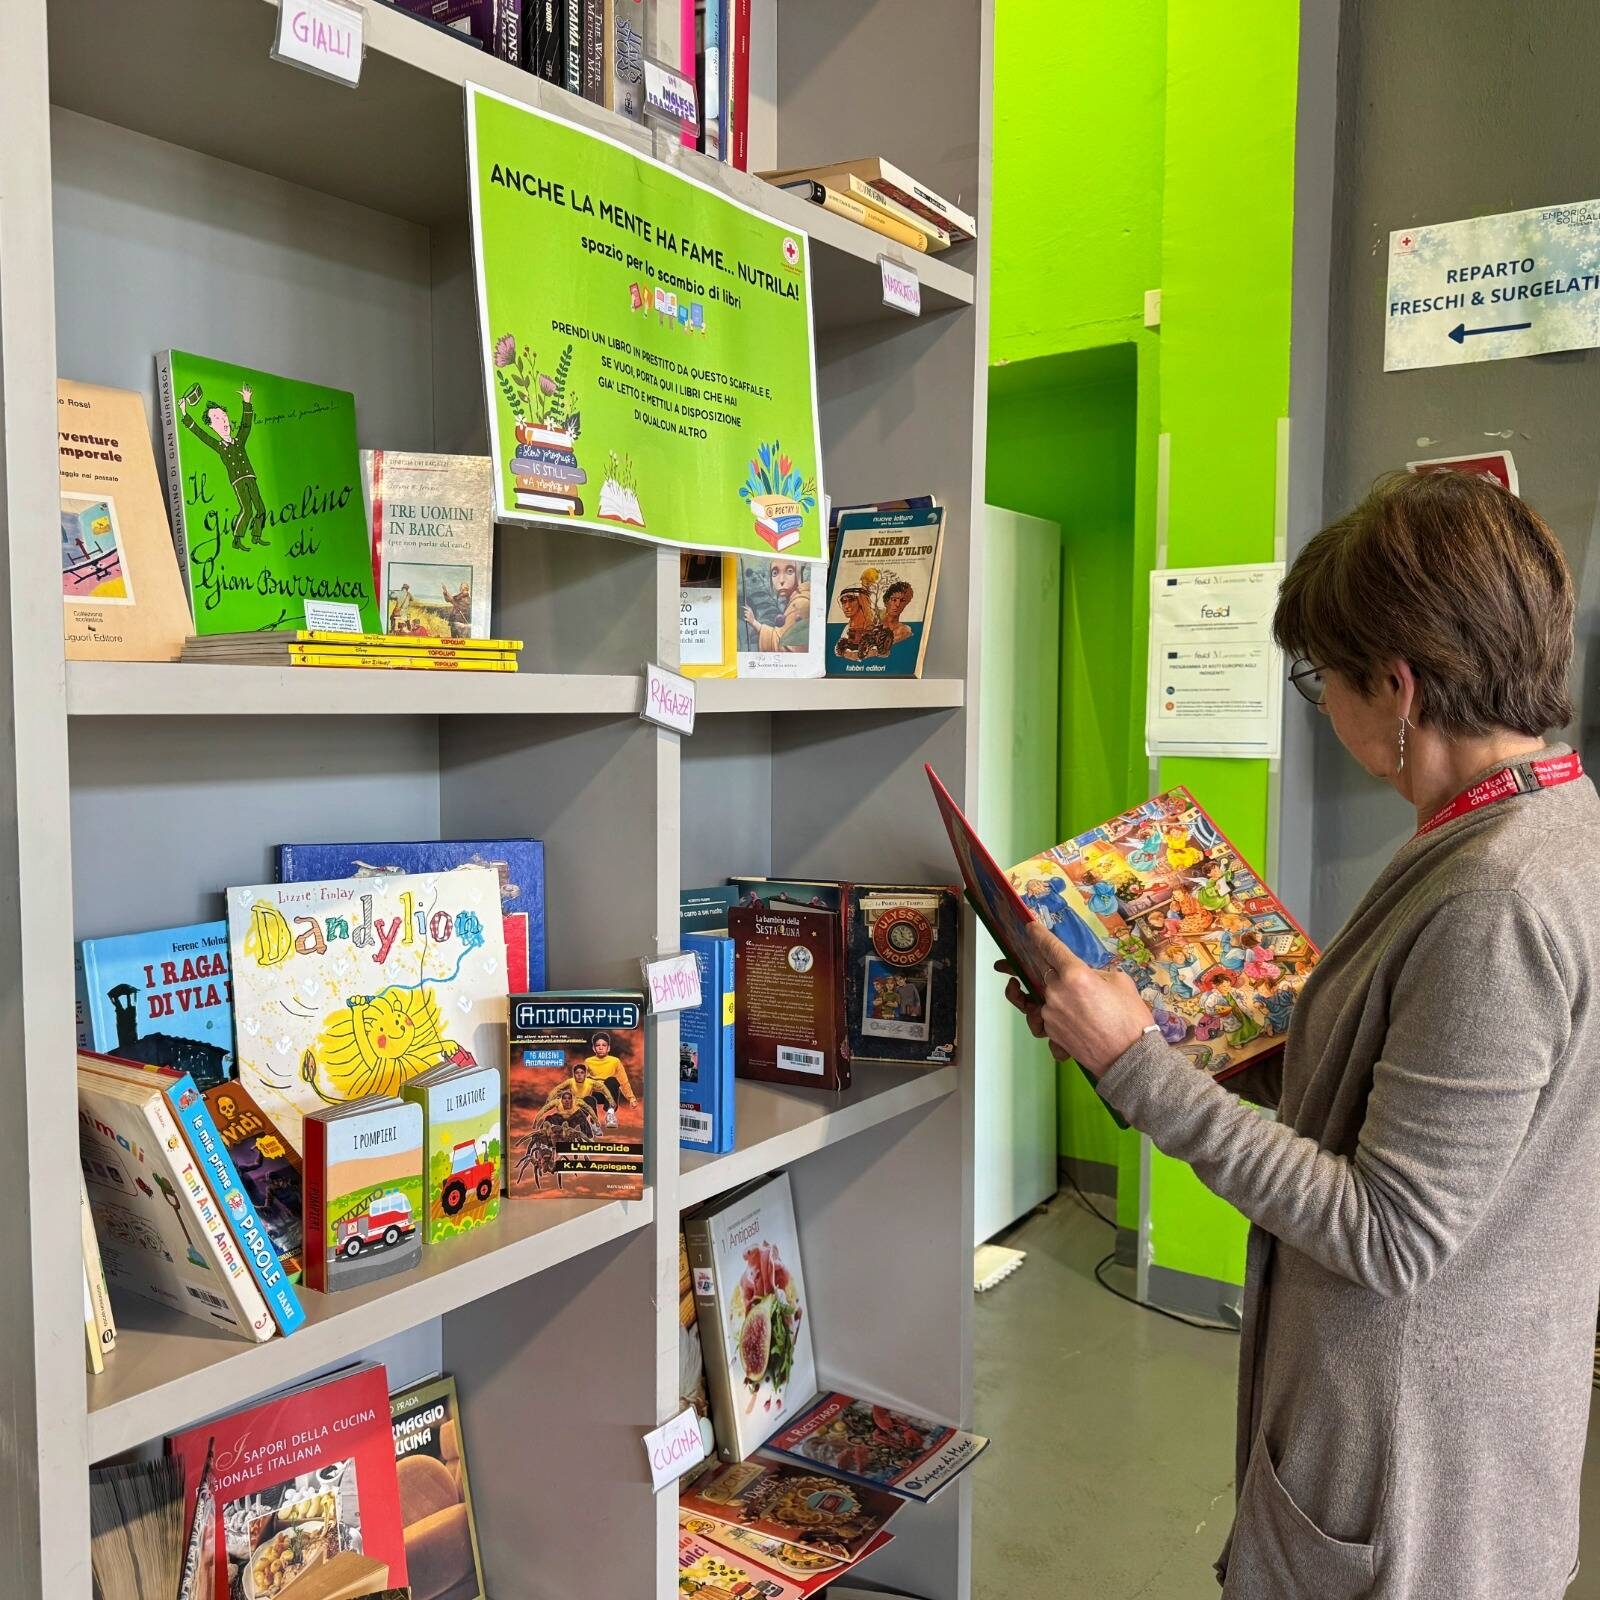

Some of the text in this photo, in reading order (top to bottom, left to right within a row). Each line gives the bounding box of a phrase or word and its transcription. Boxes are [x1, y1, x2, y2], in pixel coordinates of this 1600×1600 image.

[292, 10, 351, 59] GIALLI
[508, 10, 519, 61] LION'S
[568, 0, 580, 93] RAMA CITY
[586, 1, 595, 89] METHOD MAN
[615, 15, 632, 80] STORY
[594, 13, 603, 86] THE WATER-
[662, 86, 695, 118] INGLESE
[1543, 207, 1587, 220] EMPORIO
[490, 163, 799, 301] ANCHE LA MENTE HA FAME... NUTRILA!
[581, 234, 742, 310] spazio per lo scambio di libri
[1446, 258, 1535, 284] REPARTO
[1390, 274, 1600, 317] FRESCHI & SURGELATI
[552, 320, 773, 400] PRENDI UN LIBRO IN PRESTITO DA QUESTO SCAFFALE E,
[601, 355, 613, 369] SE
[613, 359, 636, 380] VUOI,
[636, 370, 659, 388] PORTA
[660, 378, 674, 393] QUI
[680, 385, 701, 399] LIBRI
[703, 391, 723, 405] CHE
[724, 395, 738, 407] HAI
[67, 398, 91, 409] Rossi
[160, 365, 173, 427] BURRASCA
[598, 375, 616, 390] GIA'
[616, 382, 640, 400] LETTO
[646, 393, 674, 413] METTILI
[674, 401, 681, 414] A
[682, 405, 742, 427] DISPOSIZIONE
[634, 409, 708, 440] DI QUALCUN ALTRO
[59, 446, 122, 463] mporale
[168, 432, 177, 459] GIAN
[170, 466, 178, 478] DI
[532, 463, 567, 480] IS STILL
[187, 471, 215, 506] Il
[171, 482, 185, 556] GIORNALINO
[389, 504, 474, 520] TRE UOMINI
[774, 505, 795, 516] POETRY
[284, 526, 321, 559] di
[389, 521, 454, 537] IN BARCA
[868, 536, 911, 547] INSIEME
[842, 545, 933, 559] PIANTIAMO L'ULIVO
[195, 557, 370, 611] Gian Burrasca
[1201, 604, 1230, 618] fead
[93, 633, 124, 644] Editore
[427, 650, 456, 658] TOPOLINO
[865, 663, 887, 672] editori
[650, 678, 694, 724] RAGAZZI
[1470, 792, 1490, 806] che
[277, 886, 355, 905] Lizzie Finlay
[250, 891, 484, 967] Dandylion
[755, 914, 800, 926] La bambina della
[755, 923, 778, 936] SESTA
[878, 910, 928, 931] ULYSSES
[172, 936, 228, 953] Ferenc Molna
[882, 948, 923, 964] MOORE
[143, 952, 230, 989] I RAGA
[147, 983, 222, 1019] DI VIA
[652, 970, 699, 1004] BAMBINI
[446, 1087, 486, 1112] IL TRATTORE
[353, 1126, 397, 1150] I POMPIERI
[571, 1142, 630, 1153] L'androide
[563, 1161, 637, 1171] K. A. Applegate
[180, 1162, 245, 1280] Tanti Amici Animali
[191, 1114, 296, 1320] le mie prime PAROLE DAMI
[396, 1396, 419, 1411] PRADA
[244, 1440, 287, 1464] SAPORI
[291, 1424, 329, 1447] DELLA
[333, 1408, 376, 1433] CUCINA
[785, 1402, 841, 1444] IL RICETTARIO
[395, 1428, 432, 1456] UCINA
[652, 1427, 702, 1472] CUCINA
[267, 1443, 322, 1472] ITALIANA
